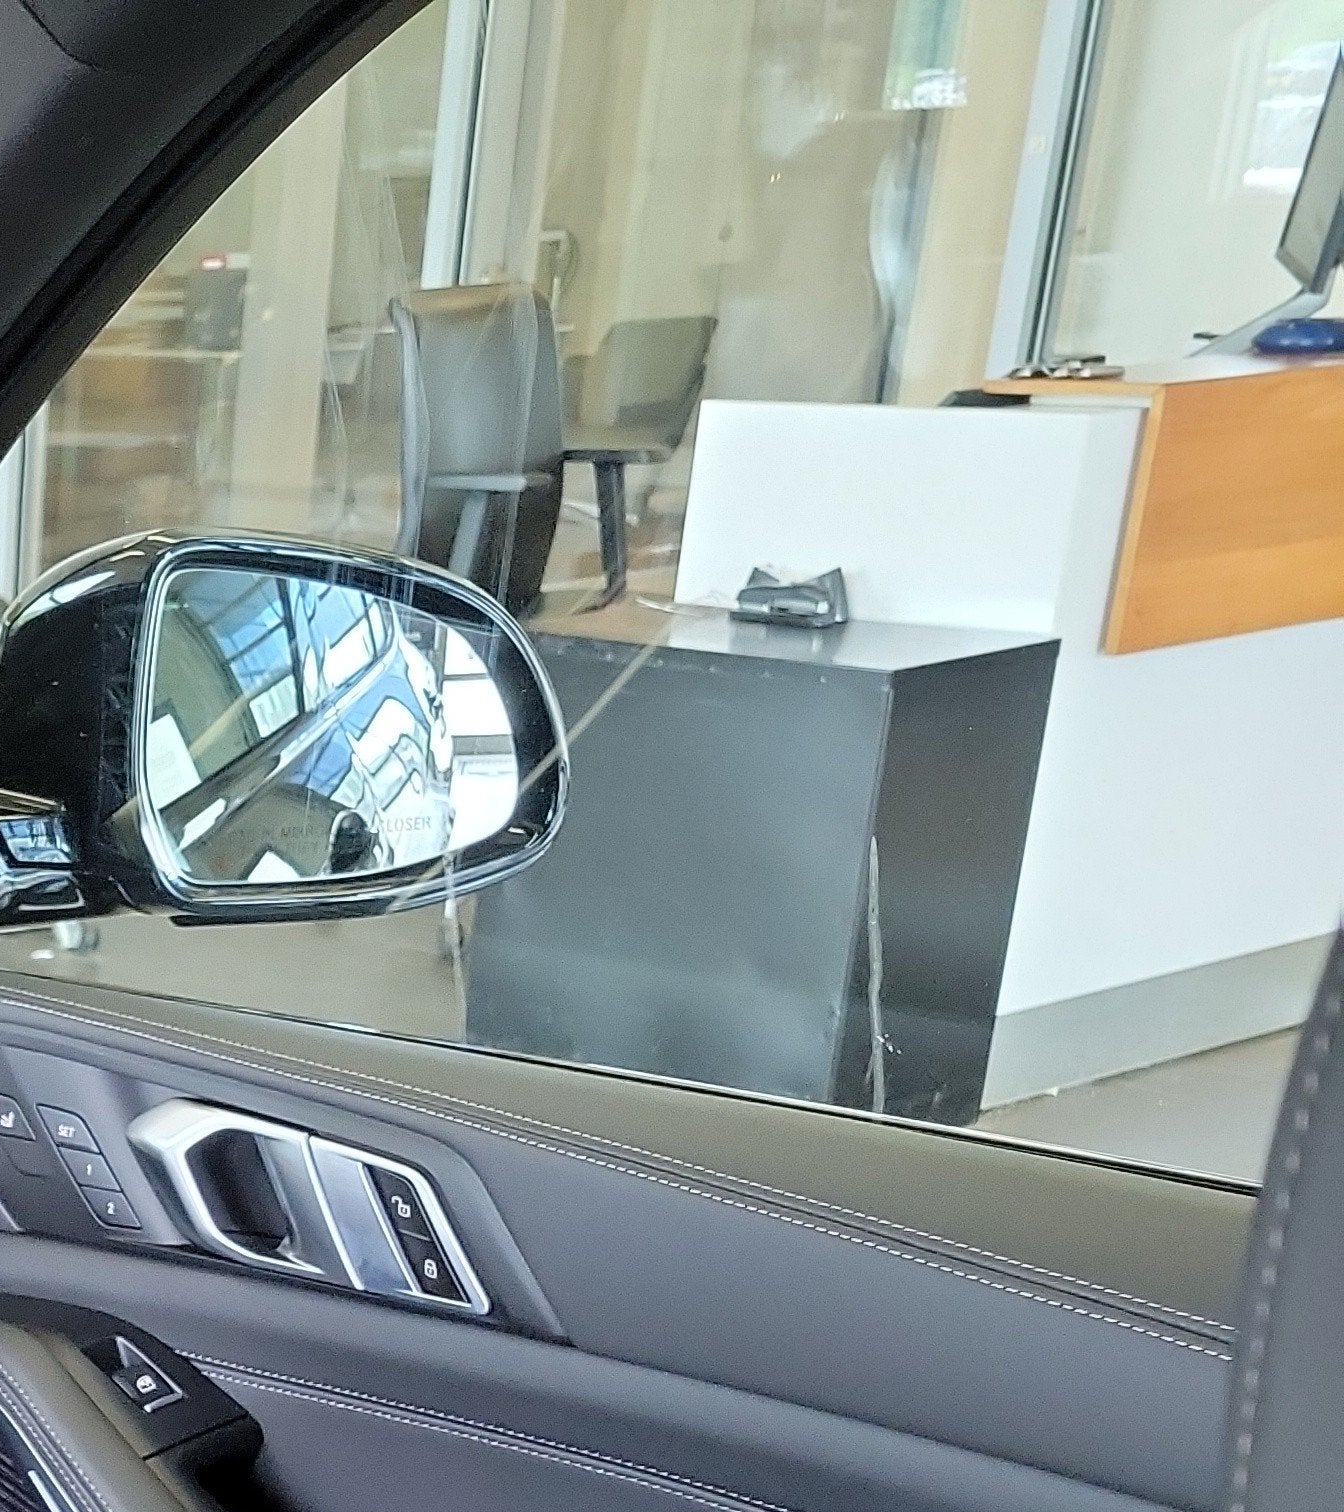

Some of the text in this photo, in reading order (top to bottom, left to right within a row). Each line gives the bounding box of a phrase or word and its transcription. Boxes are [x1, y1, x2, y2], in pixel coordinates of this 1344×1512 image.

[57, 1124, 76, 1138] SET
[86, 1163, 92, 1176] 1
[106, 1201, 115, 1215] 2
